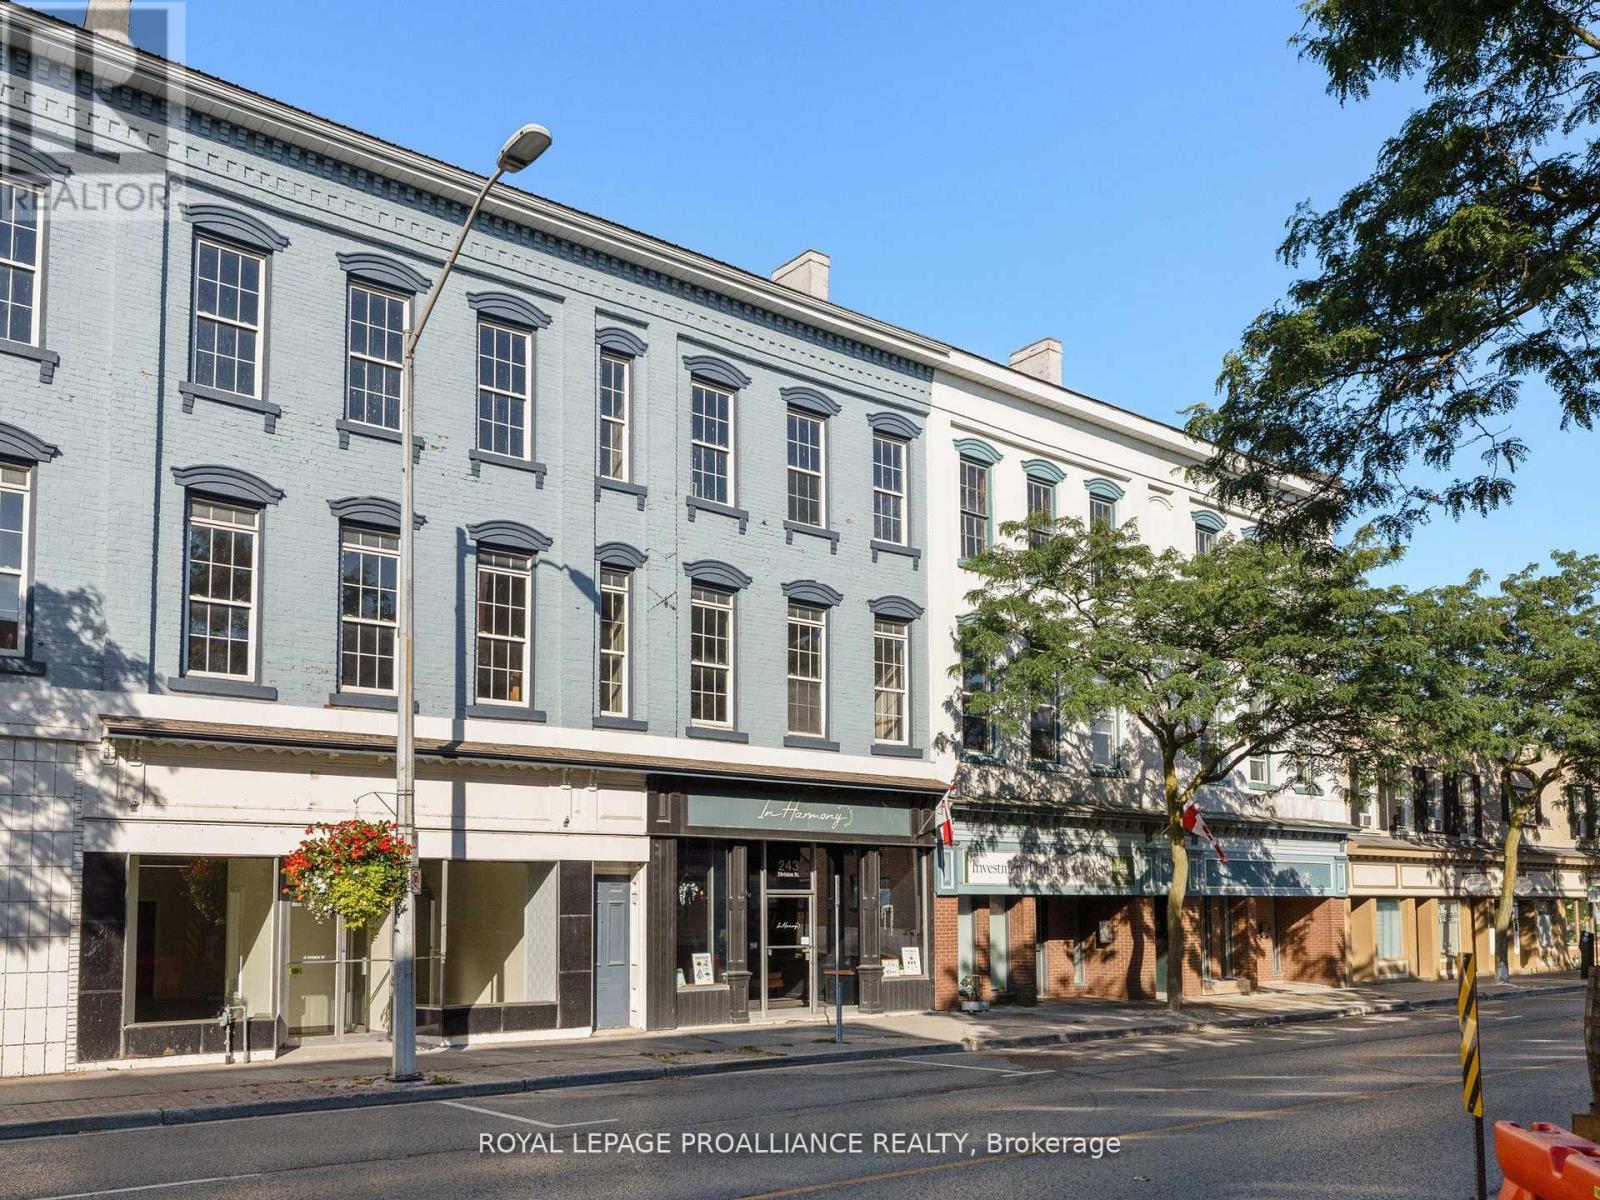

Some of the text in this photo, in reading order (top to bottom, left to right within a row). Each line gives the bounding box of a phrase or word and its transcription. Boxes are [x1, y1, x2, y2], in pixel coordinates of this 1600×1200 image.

[757, 799, 848, 829] In Harmony
[778, 859, 800, 871] 243
